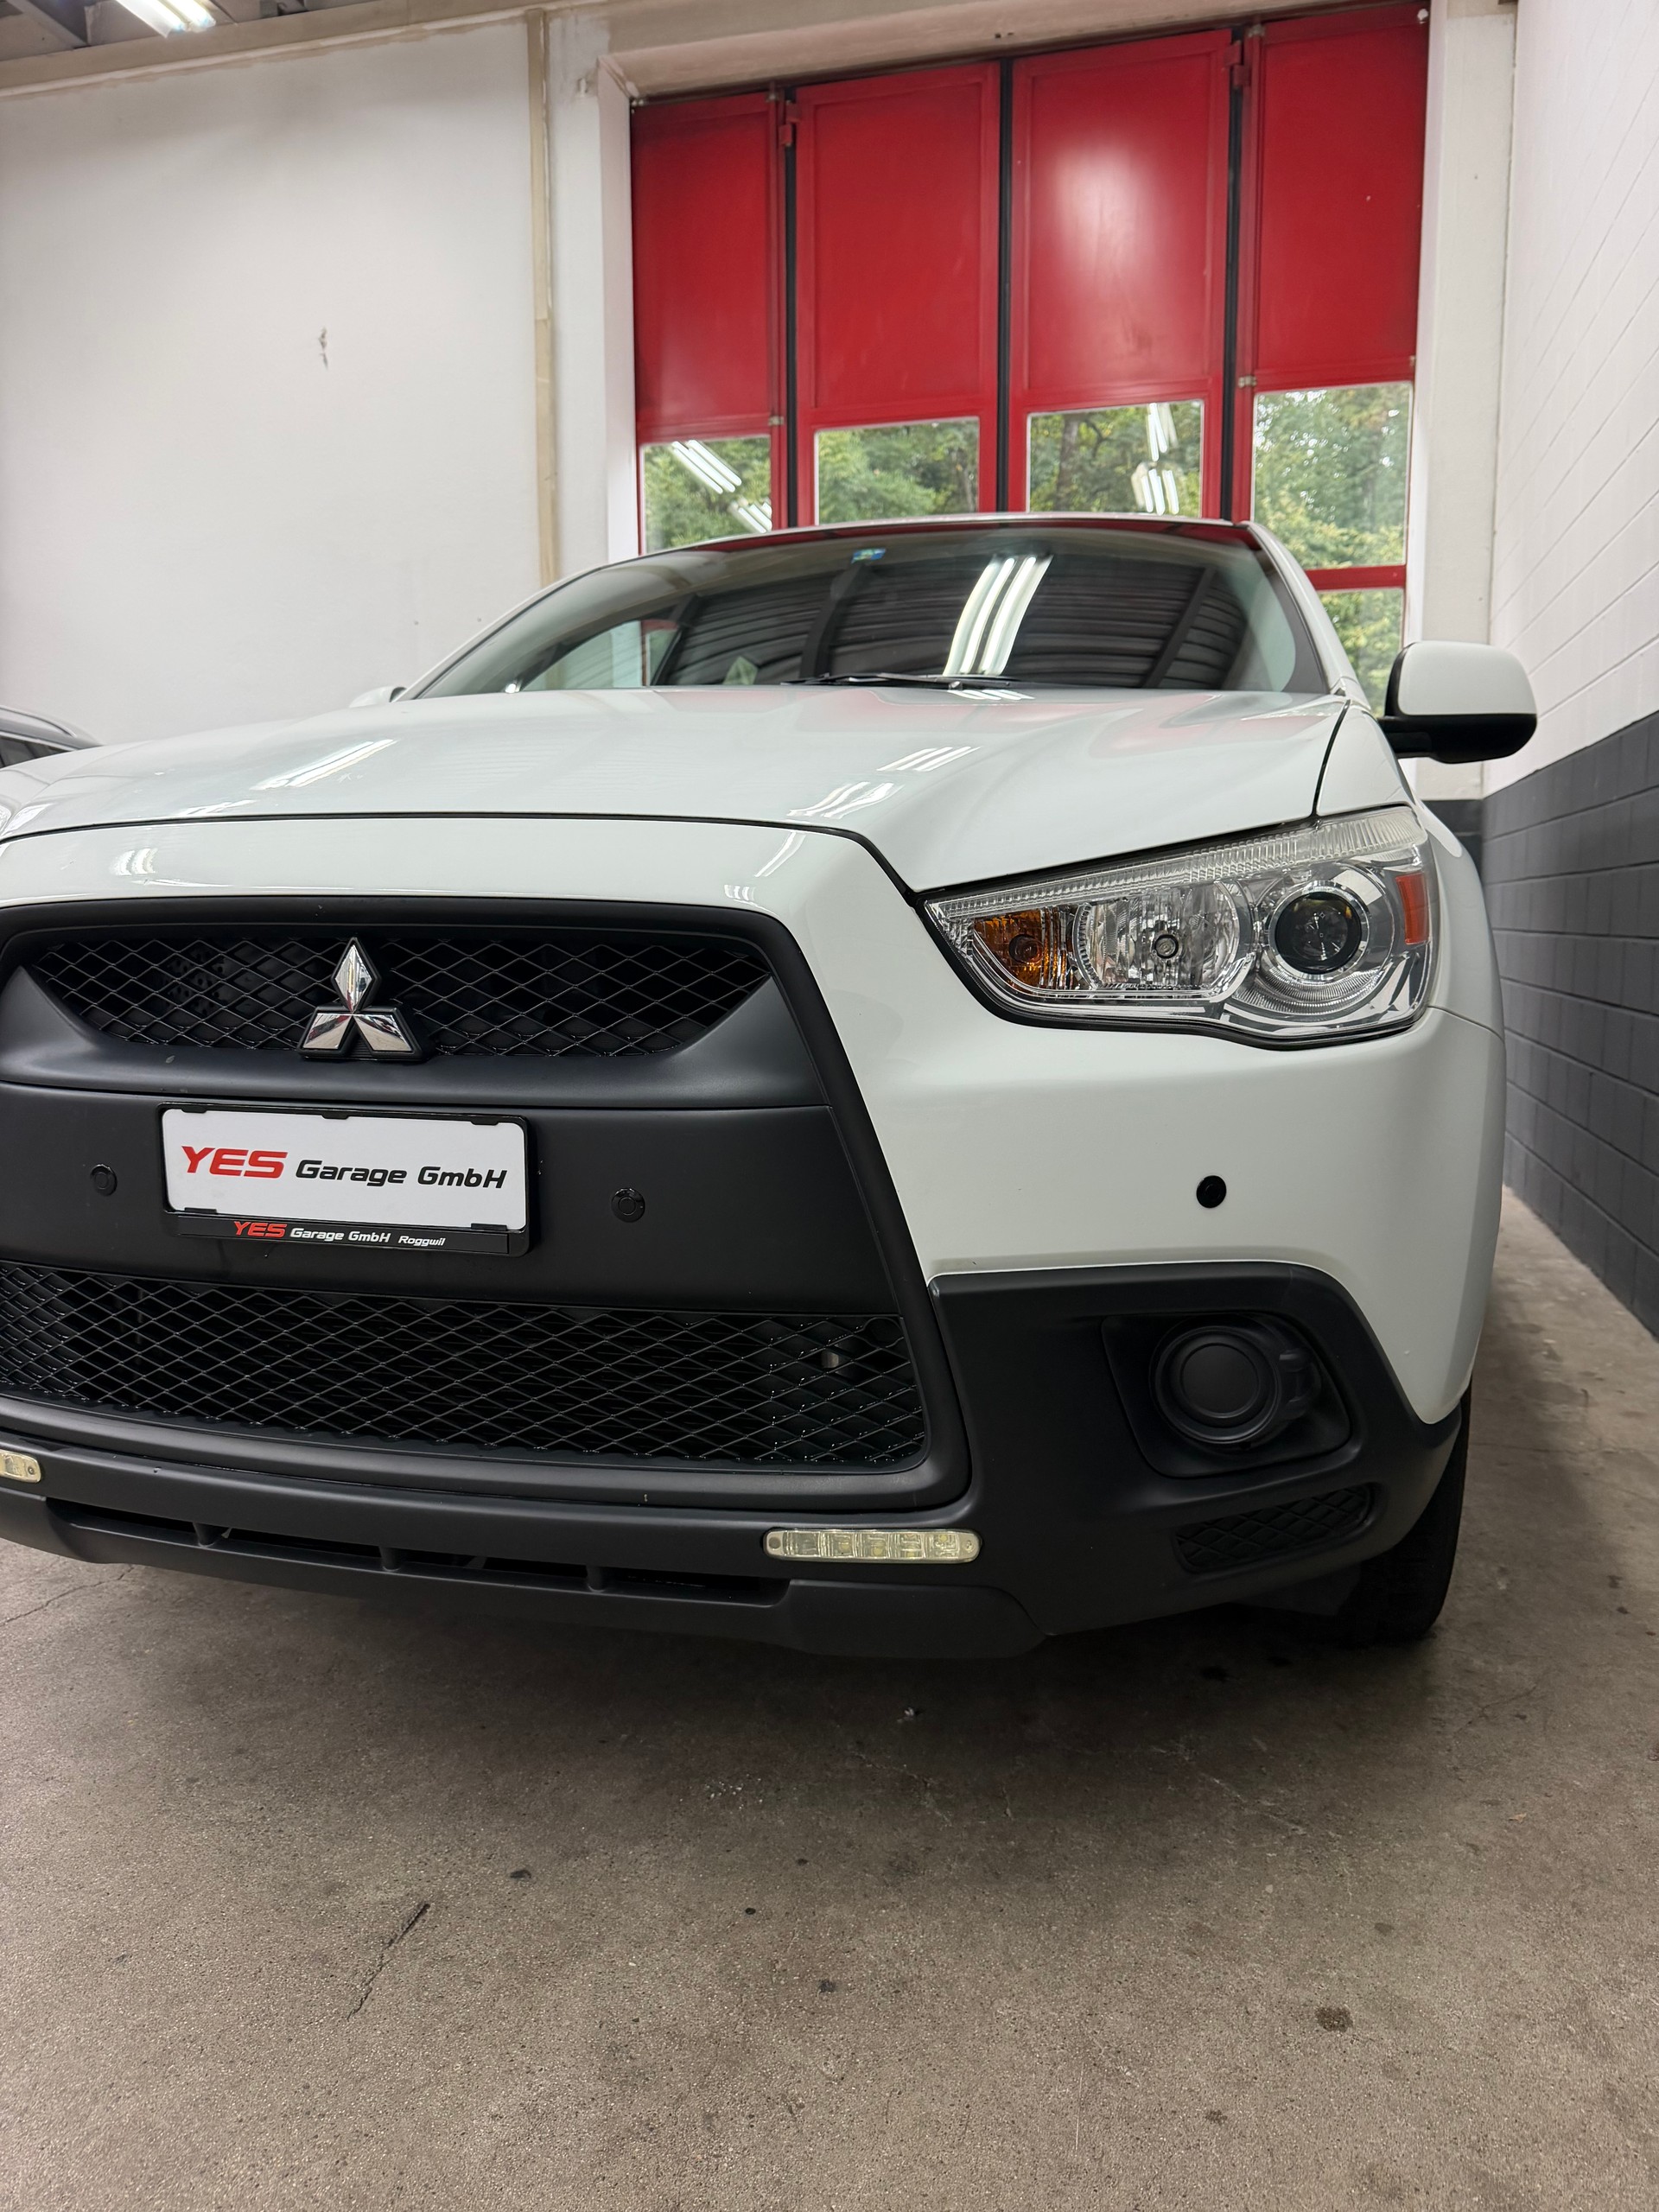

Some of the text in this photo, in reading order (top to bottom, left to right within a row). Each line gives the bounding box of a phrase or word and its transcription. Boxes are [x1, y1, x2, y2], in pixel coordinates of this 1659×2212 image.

[181, 1145, 507, 1189] YES Garage GmbH
[233, 1221, 446, 1247] YES Garage GmbH Roggwil
